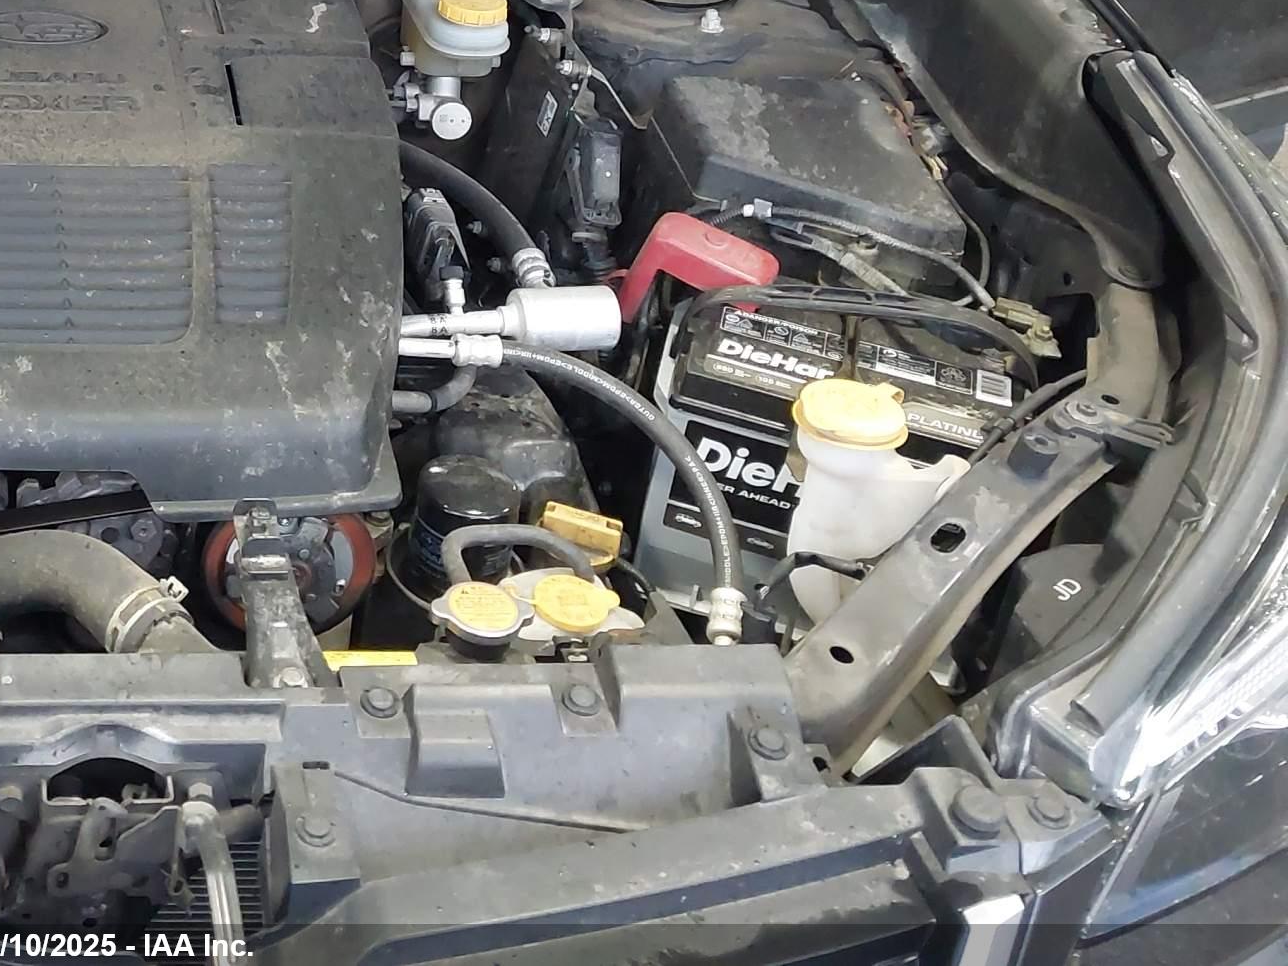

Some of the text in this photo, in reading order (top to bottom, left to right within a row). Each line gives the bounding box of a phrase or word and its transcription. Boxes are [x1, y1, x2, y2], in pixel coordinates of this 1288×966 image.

[717, 338, 835, 380] DieHar
[696, 436, 803, 498] DieH
[737, 490, 792, 510] AHEAD
